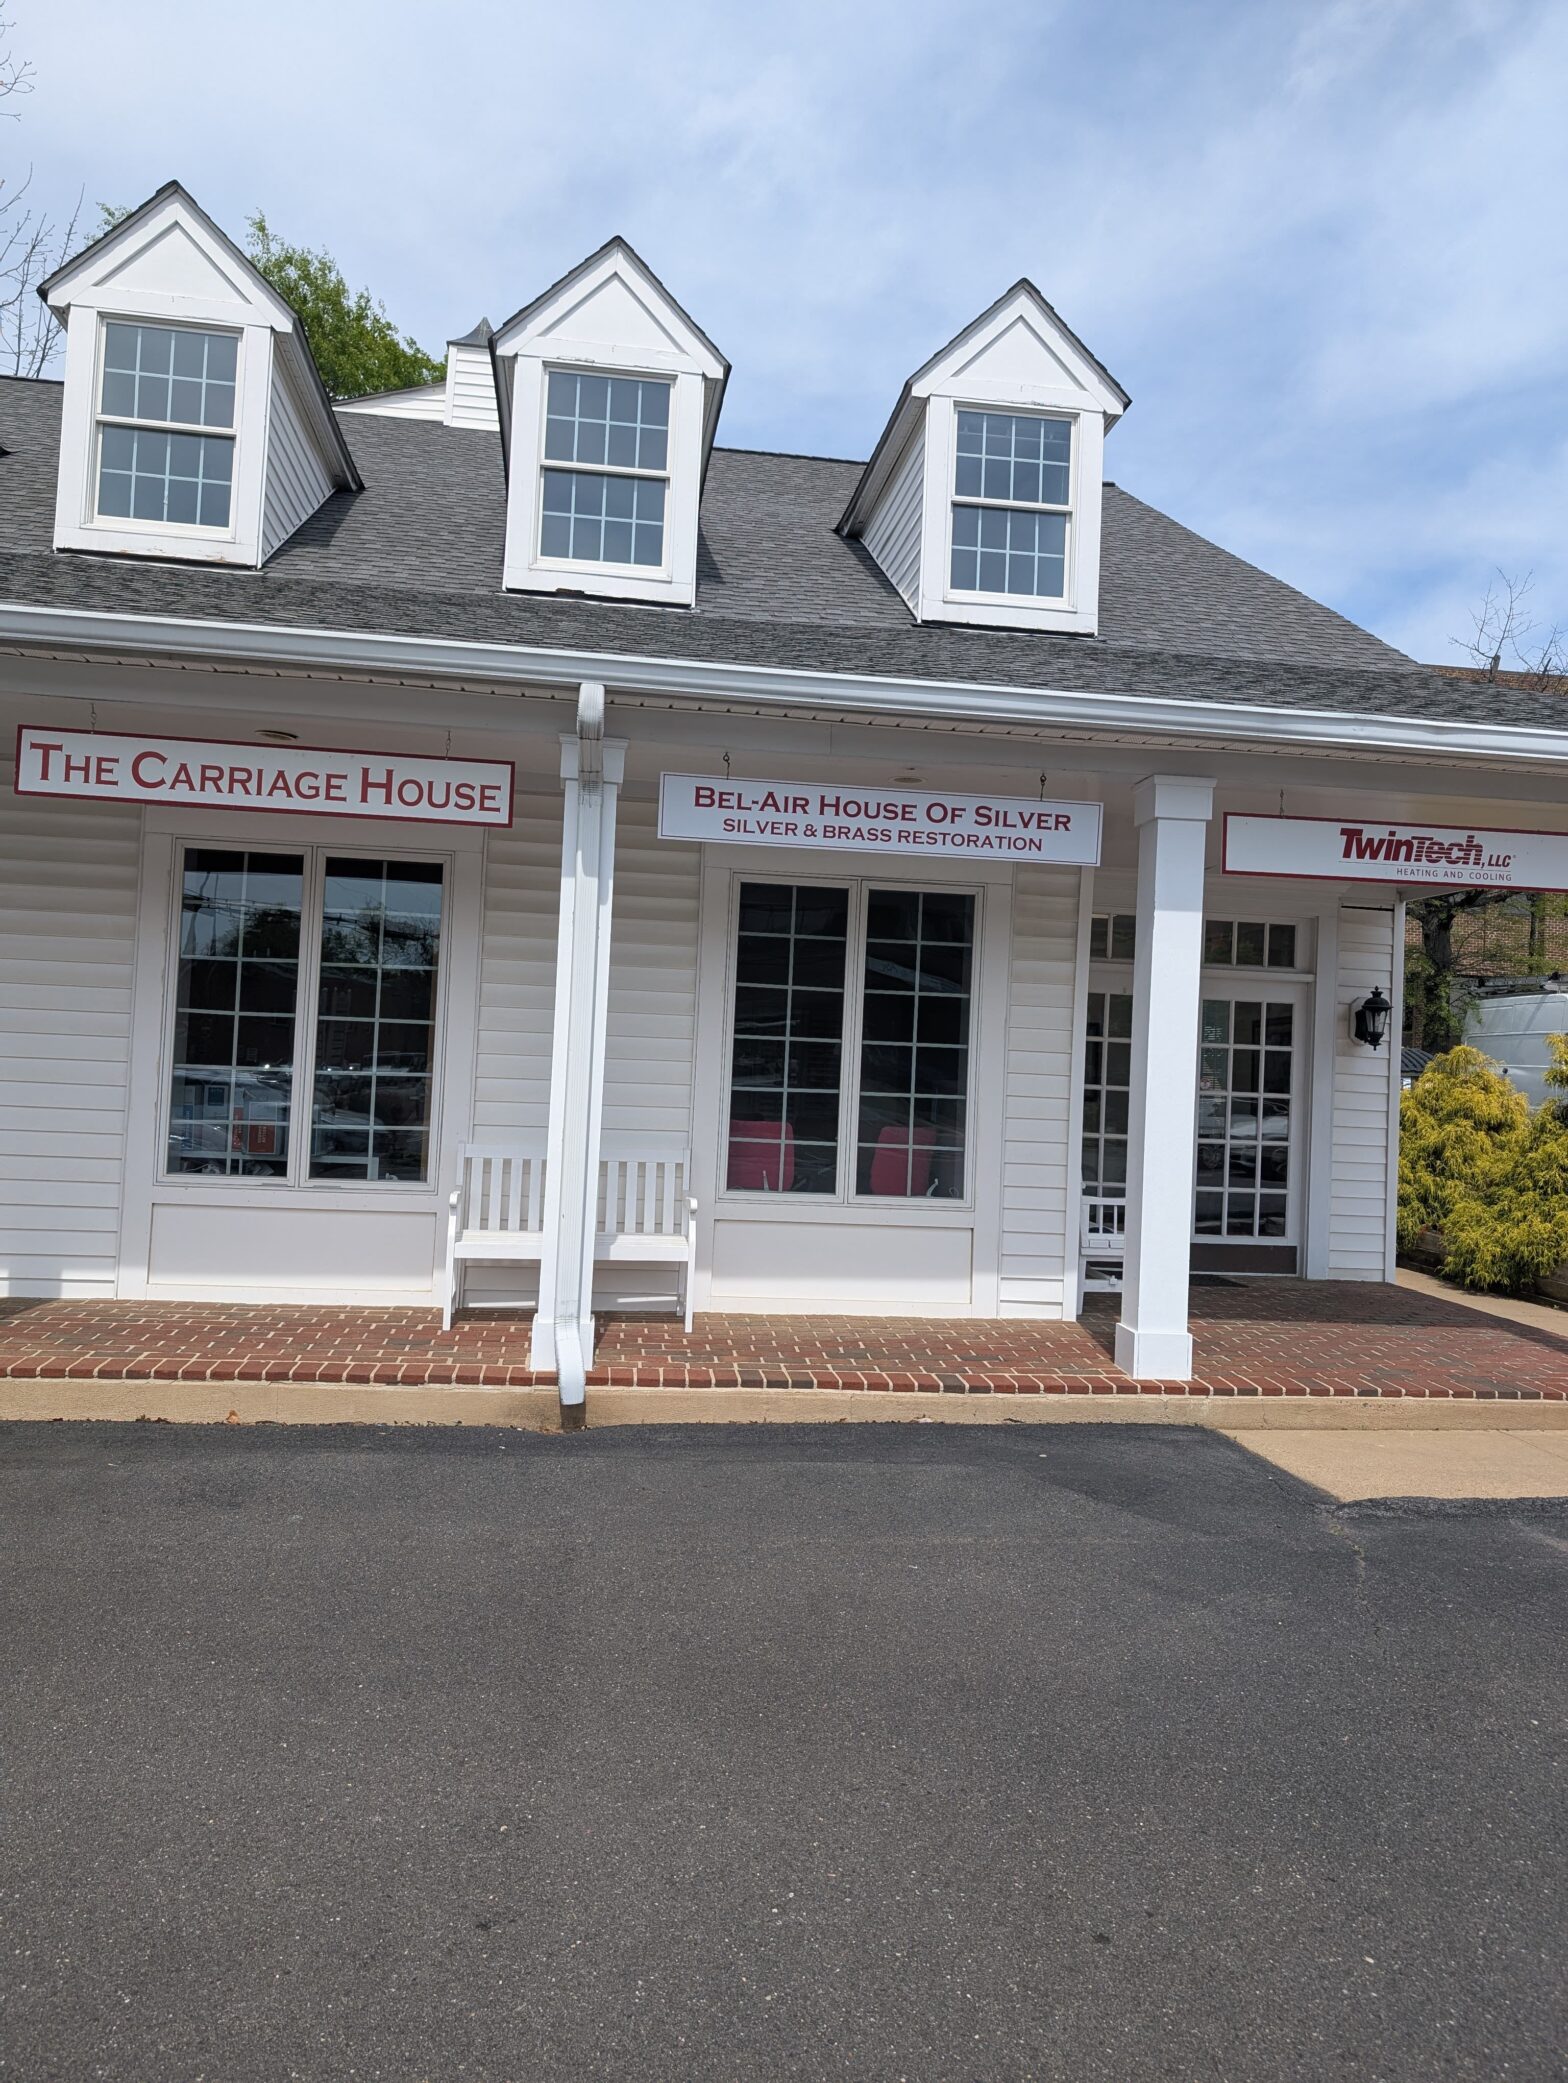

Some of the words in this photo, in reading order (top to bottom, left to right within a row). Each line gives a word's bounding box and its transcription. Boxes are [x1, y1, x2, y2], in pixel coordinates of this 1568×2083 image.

[29, 741, 120, 786] THE
[130, 750, 350, 803] CARRIAGE
[359, 766, 503, 813] HOUSE
[694, 785, 810, 816] BEL-AIR
[818, 795, 917, 823] HOUSE
[925, 802, 967, 825] OF
[973, 806, 1072, 832] SILVER
[722, 818, 799, 837] SILVER
[803, 824, 818, 838] &
[822, 825, 893, 843] BRASS
[897, 830, 1043, 852] RESTORATION
[1396, 868, 1439, 878] HEATING
[1443, 870, 1463, 879] AND
[1469, 872, 1512, 882] COOLING
